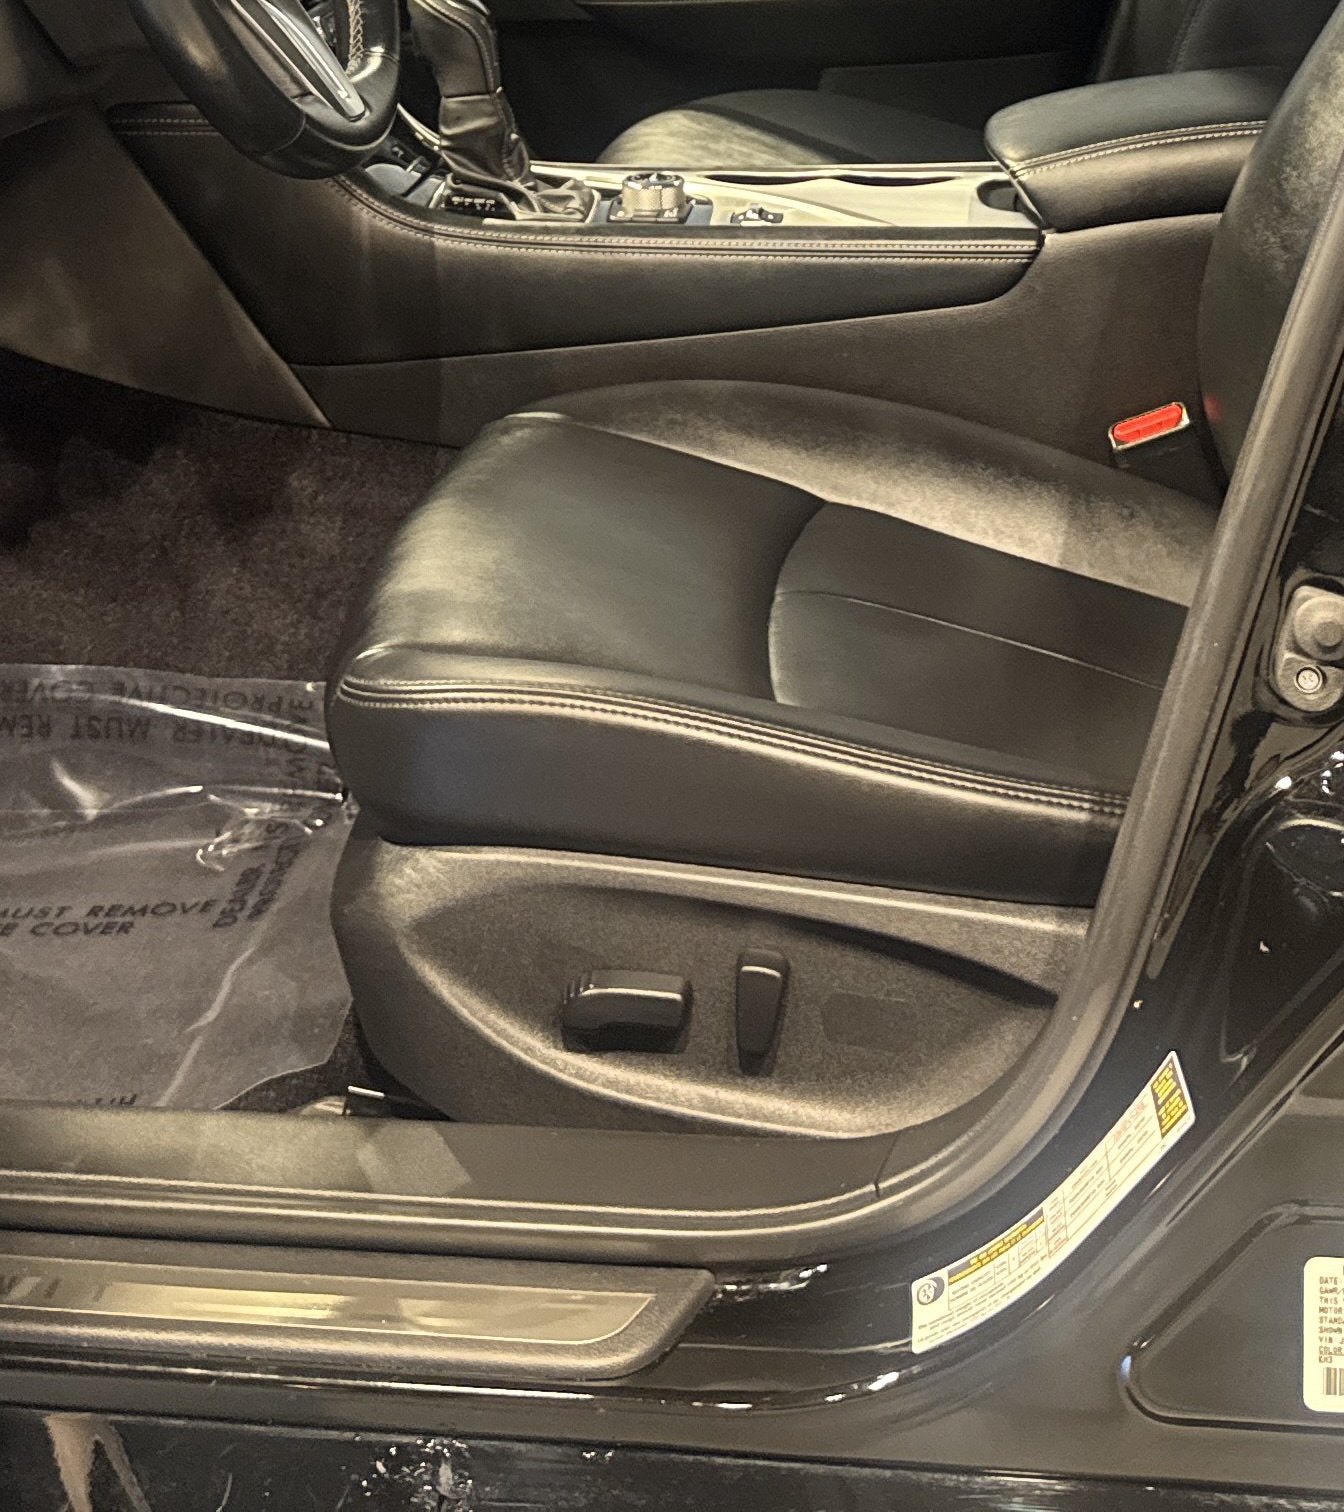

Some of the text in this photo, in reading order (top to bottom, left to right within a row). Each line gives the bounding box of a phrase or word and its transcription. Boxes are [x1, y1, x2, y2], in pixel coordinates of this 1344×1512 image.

[69, 713, 153, 742] MUST
[84, 897, 219, 919] REMOVE
[29, 918, 137, 939] COVER
[1319, 1296, 1338, 1305] THIS
[1318, 1306, 1343, 1316] MOTOR
[1318, 1325, 1342, 1335] SHOWN
[1318, 1345, 1342, 1356] COLOR
